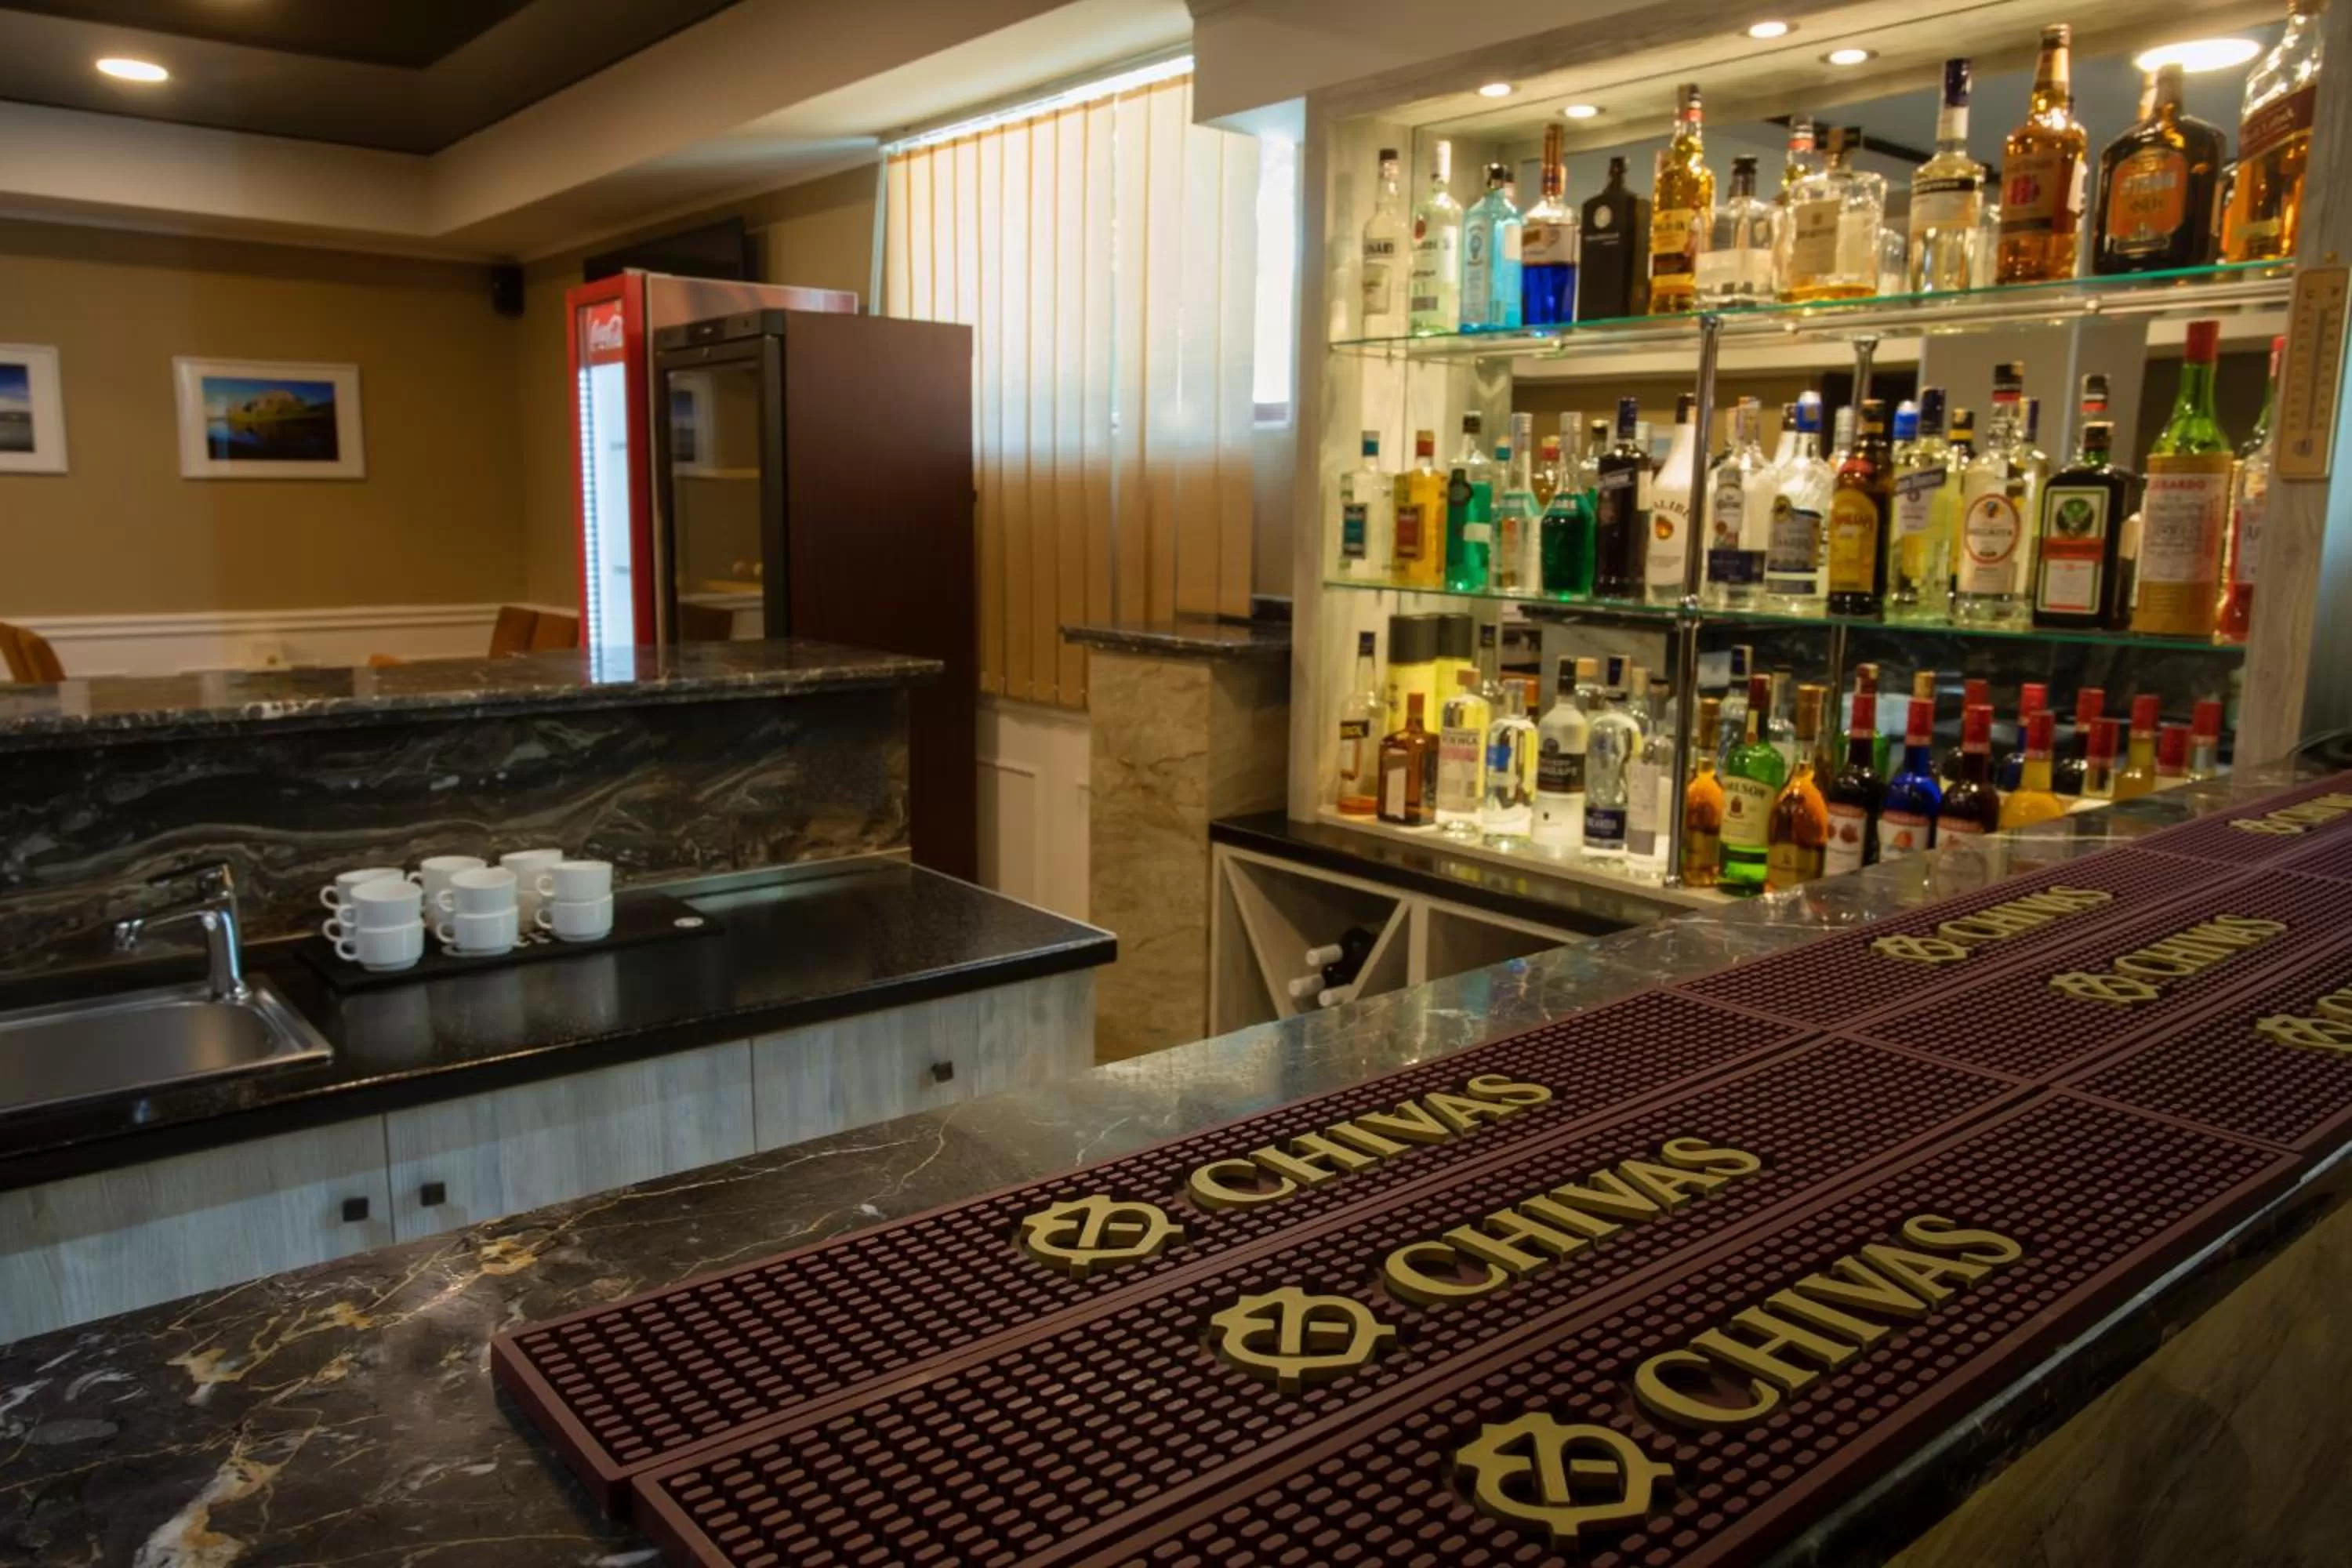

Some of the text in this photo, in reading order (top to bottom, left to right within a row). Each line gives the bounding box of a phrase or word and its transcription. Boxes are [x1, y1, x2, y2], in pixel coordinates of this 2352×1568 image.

[1939, 885, 2114, 941] CHIVAS
[2114, 913, 2288, 977] CHIVAS
[1189, 1073, 1553, 1210] CHIVAS
[1384, 1137, 1762, 1305] CHIVAS
[1634, 1214, 2023, 1423] CHIVAS
